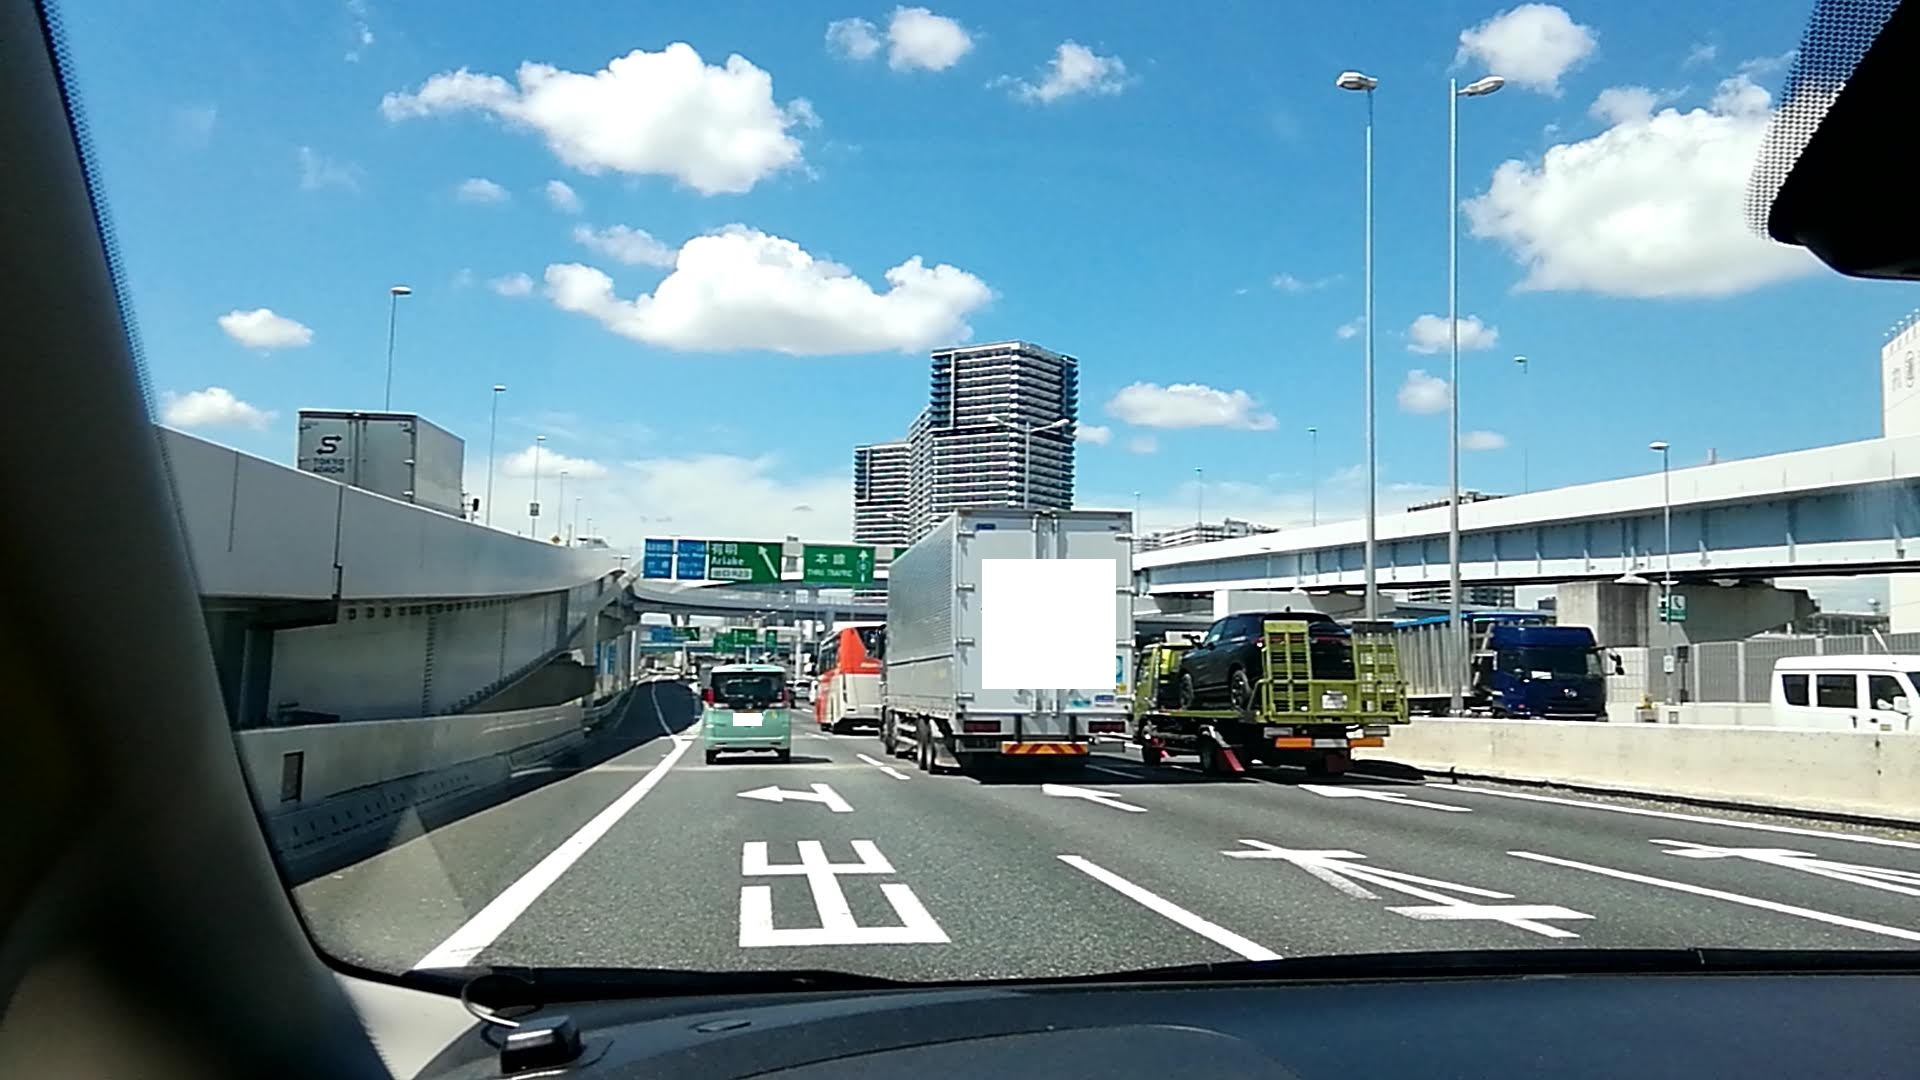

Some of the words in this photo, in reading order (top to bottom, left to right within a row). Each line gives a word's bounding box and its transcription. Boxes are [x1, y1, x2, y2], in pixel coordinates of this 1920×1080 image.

[711, 543, 738, 556] 有明
[711, 555, 745, 566] Ariake
[738, 839, 952, 948] 出
